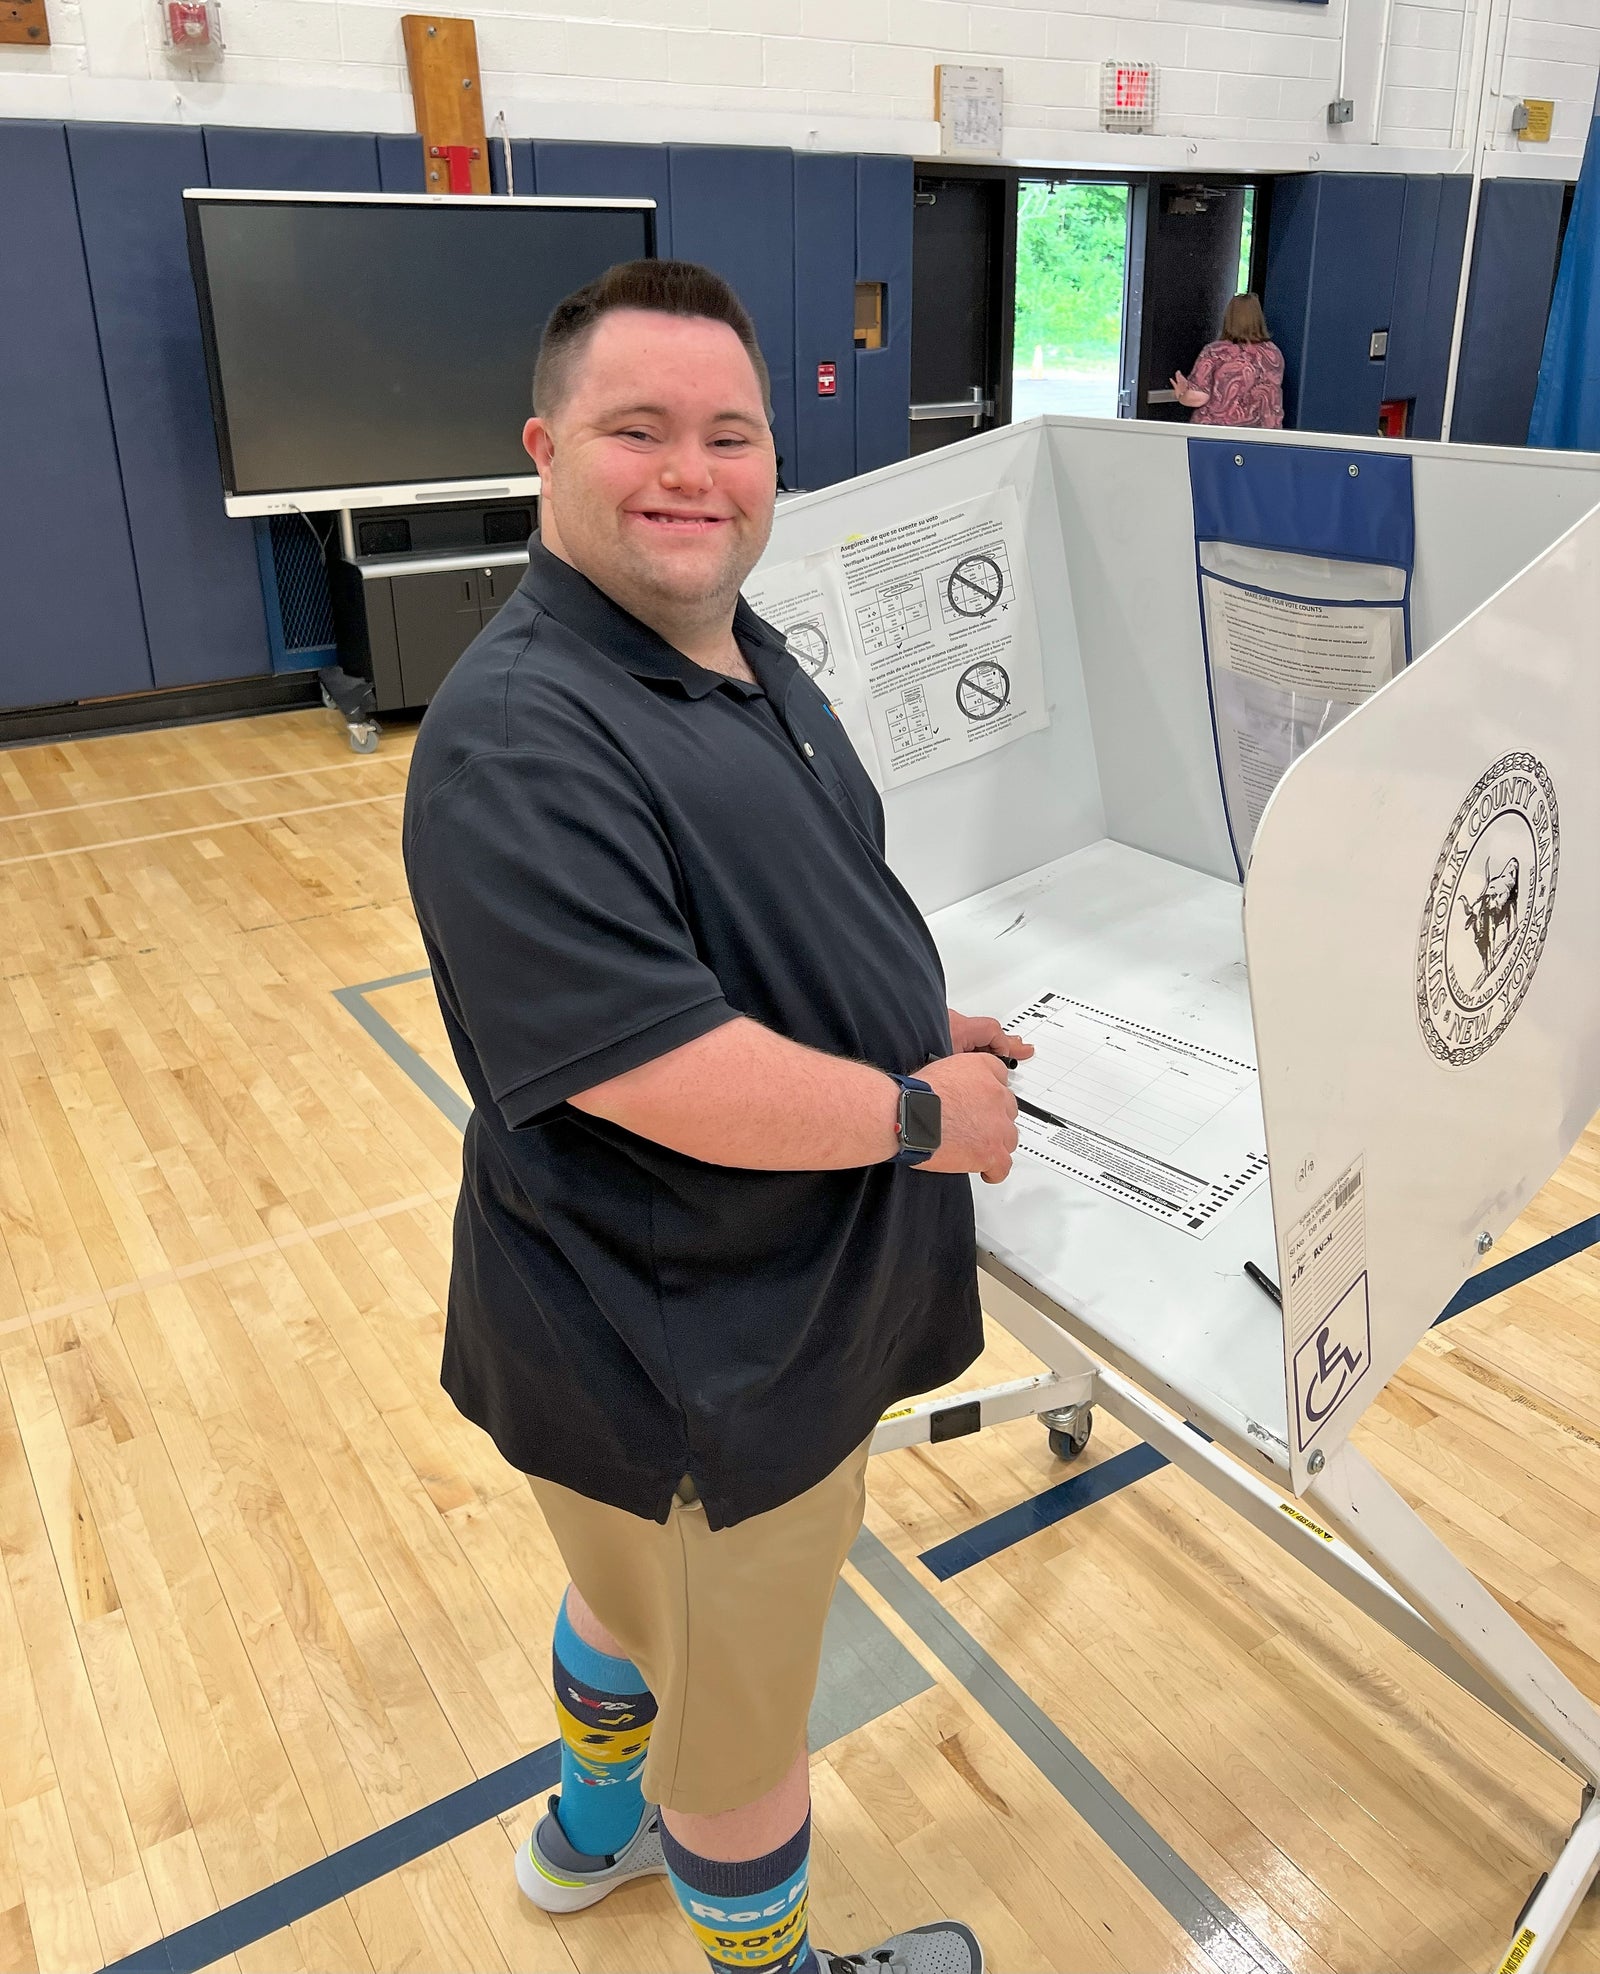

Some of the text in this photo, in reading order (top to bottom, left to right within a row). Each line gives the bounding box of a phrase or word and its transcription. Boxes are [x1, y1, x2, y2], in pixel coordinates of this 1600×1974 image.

[840, 539, 869, 552] Asegúrese
[926, 515, 938, 523] voto
[1244, 591, 1322, 613] MAKE SURE YOUR VOTE COUNTS
[1426, 777, 1551, 1016] SUFFOLK COUNTY SEAL
[1446, 905, 1546, 1045] NEW YORK
[1475, 987, 1494, 1006] AND
[1101, 1172, 1131, 1188] Proposition
[1139, 1189, 1156, 1199] Other
[1155, 1196, 1168, 1205] Side
